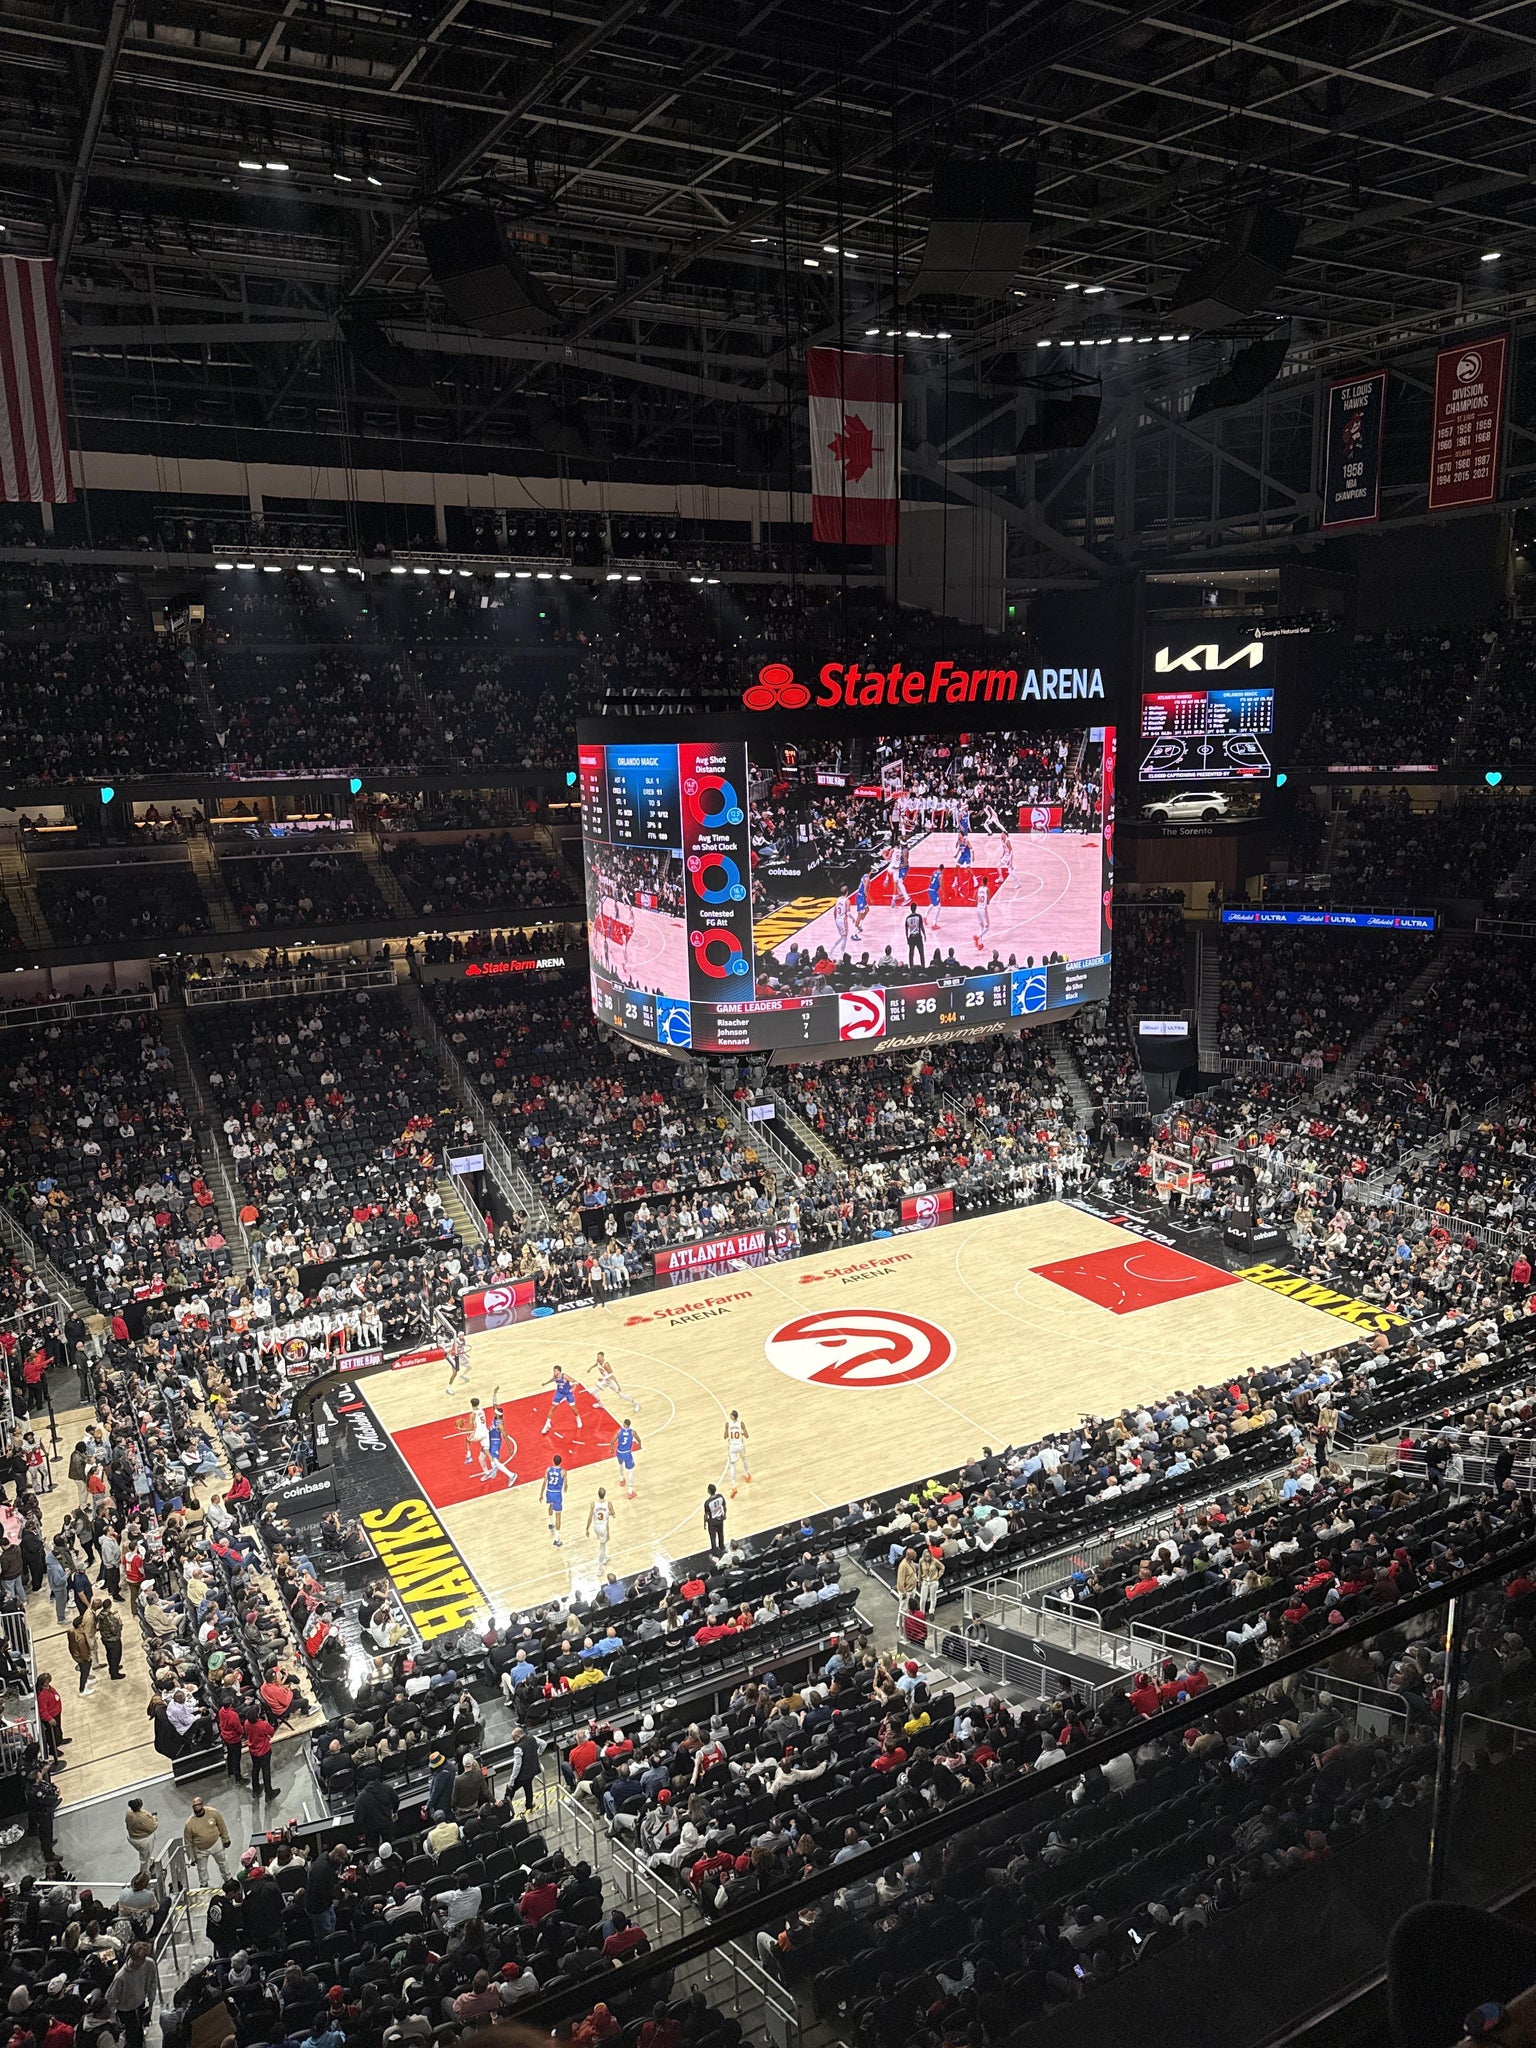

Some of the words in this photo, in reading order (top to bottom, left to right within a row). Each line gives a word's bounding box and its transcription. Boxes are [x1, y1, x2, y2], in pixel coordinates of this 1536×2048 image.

[1341, 388, 1351, 400] ST.
[1352, 383, 1373, 398] LOUIS
[1452, 383, 1484, 400] DIVISION
[1343, 395, 1369, 411] HAWKS
[1445, 395, 1489, 415] CHAMPIONS
[1437, 427, 1453, 439] 1957
[1456, 423, 1472, 435] 1958
[1475, 418, 1492, 431] 1959
[1437, 438, 1452, 451] 1960
[1456, 435, 1471, 447] 1961
[1475, 431, 1491, 444] 1968
[1342, 462, 1364, 478] 1958
[1437, 462, 1452, 474] 1970
[1455, 458, 1471, 470] 1980
[1474, 454, 1491, 466] 1987
[1345, 478, 1358, 489] NBA
[1436, 473, 1451, 486] 1994
[1453, 471, 1470, 483] 2015
[1472, 467, 1489, 479] 2021
[1335, 487, 1367, 502] CHAMPIONS
[1262, 629, 1280, 637] Georgia
[1281, 627, 1299, 636] Natural
[1300, 626, 1310, 634] Gas
[1020, 668, 1105, 701] ARENA
[618, 758, 640, 766] ORLANDO
[641, 757, 659, 766] MAGIC
[695, 756, 709, 765] Avg
[709, 756, 727, 764] Shot
[1161, 828, 1177, 836] The
[1179, 826, 1213, 835] Sorento
[698, 834, 711, 843] Avg
[712, 834, 730, 842] Time
[692, 843, 701, 851] on
[701, 843, 718, 851] Shot
[718, 842, 738, 851] Clock
[768, 867, 801, 876] coinbase
[700, 910, 735, 918] Contested
[706, 919, 716, 927] FG
[716, 919, 729, 927] Att
[536, 958, 565, 969] ARENA
[1066, 962, 1082, 971] GAME
[1083, 956, 1105, 968] LEADERS
[604, 994, 613, 1011] 36
[801, 999, 814, 1007] PTS
[965, 991, 985, 1008] 23
[1065, 992, 1078, 1000] Black
[625, 1003, 638, 1019] 23
[716, 1003, 743, 1013] GAME
[744, 1001, 782, 1012] LEADERS
[916, 997, 937, 1015] 36
[717, 1018, 750, 1027] Risacher
[801, 1013, 810, 1021] 13
[939, 1011, 957, 1025] 9:44
[717, 1028, 748, 1037] Johnson
[873, 1020, 1006, 1052] globalpayments
[718, 1037, 750, 1046] Kennard
[893, 1222, 925, 1235] AT&T
[1122, 1222, 1178, 1246] ULTRA
[669, 1240, 736, 1269] ATLANTA
[841, 1267, 897, 1285] ARENA
[557, 1297, 596, 1312] AT&T
[1233, 1263, 1411, 1333] HAWKS
[669, 1306, 732, 1327] ARENA
[340, 1359, 352, 1371] GET
[353, 1356, 365, 1368] THE
[480, 1416, 485, 1424] 5
[621, 1437, 628, 1445] 3
[730, 1431, 740, 1439] 10
[549, 1476, 559, 1485] 23
[283, 1480, 331, 1499] coinbase
[598, 1512, 604, 1521] 3
[359, 1499, 492, 1641] HAWKS
[664, 1822, 670, 1836] 1
